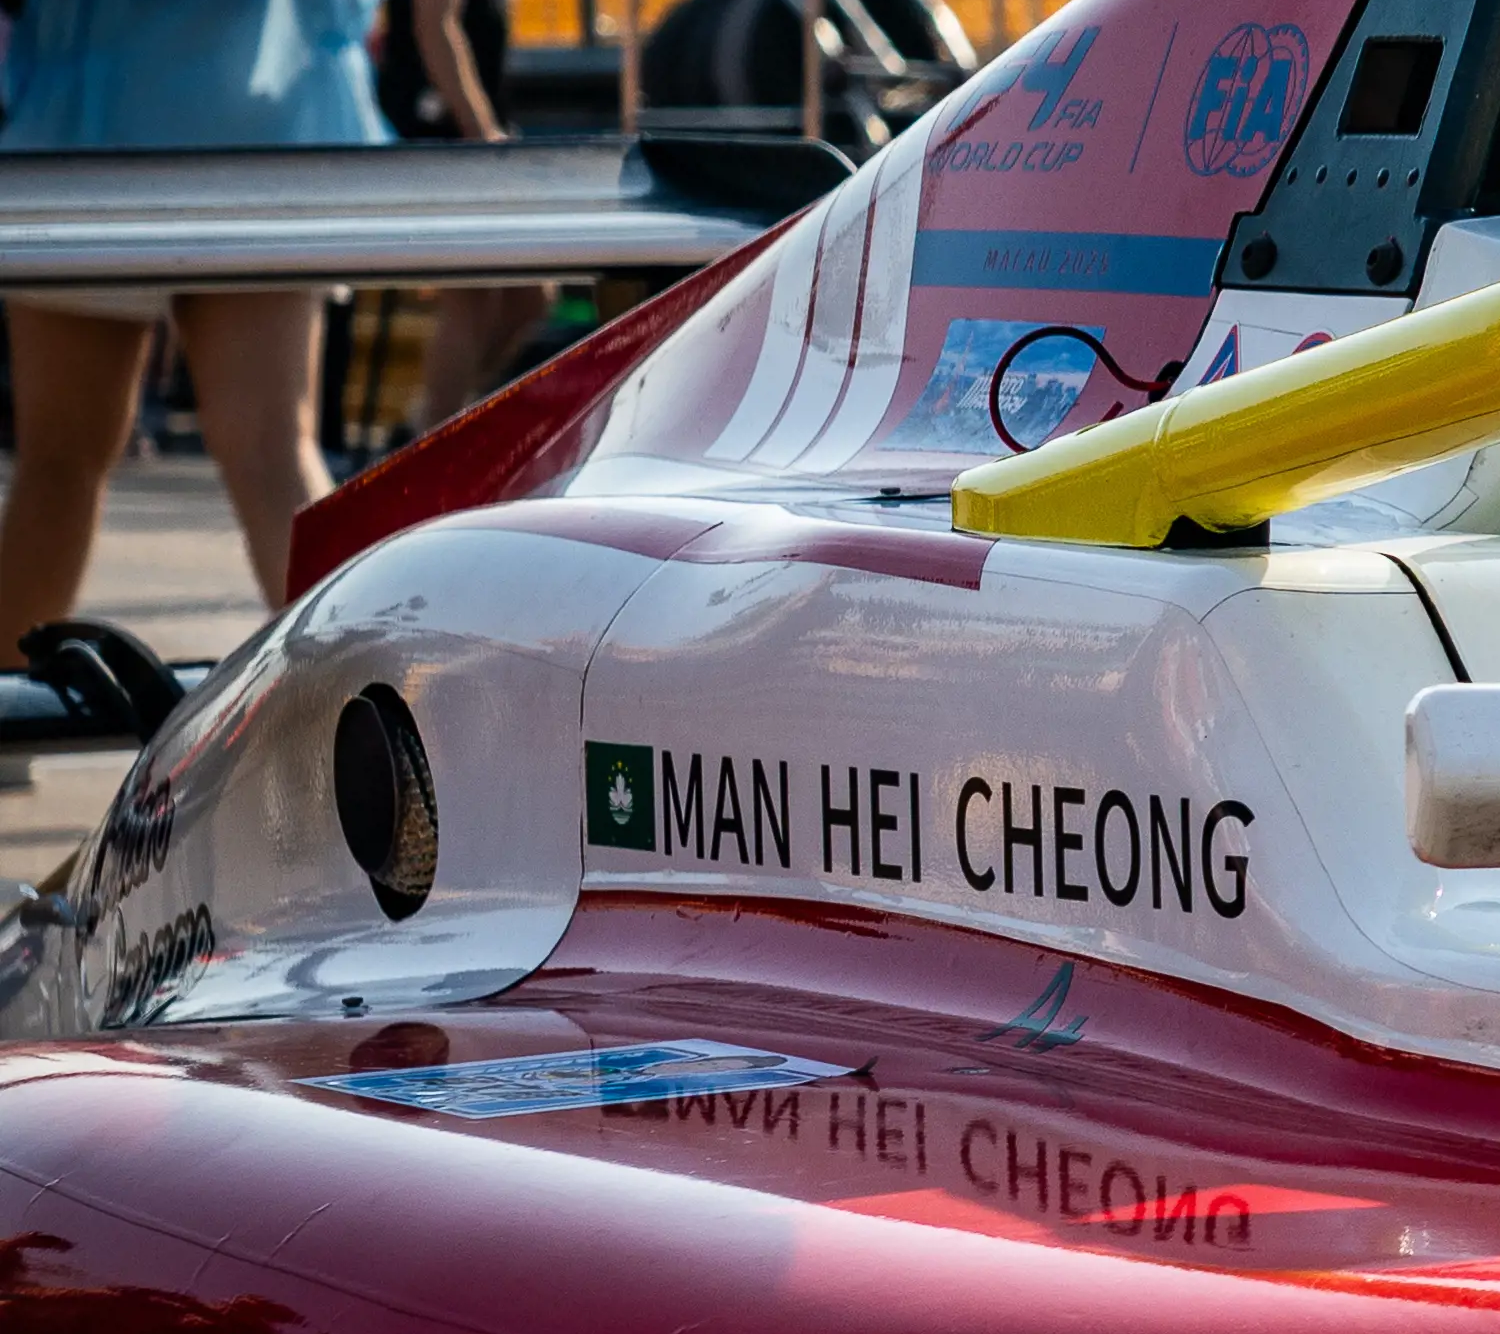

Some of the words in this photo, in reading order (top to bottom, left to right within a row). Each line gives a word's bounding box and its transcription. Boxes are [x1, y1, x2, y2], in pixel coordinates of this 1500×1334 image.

[1054, 97, 1103, 131] FIA
[1022, 141, 1085, 173] CUP
[983, 247, 1052, 273] MACAU
[659, 748, 792, 871] MAN
[820, 764, 924, 884] HEI
[955, 775, 1256, 919] CHEONG
